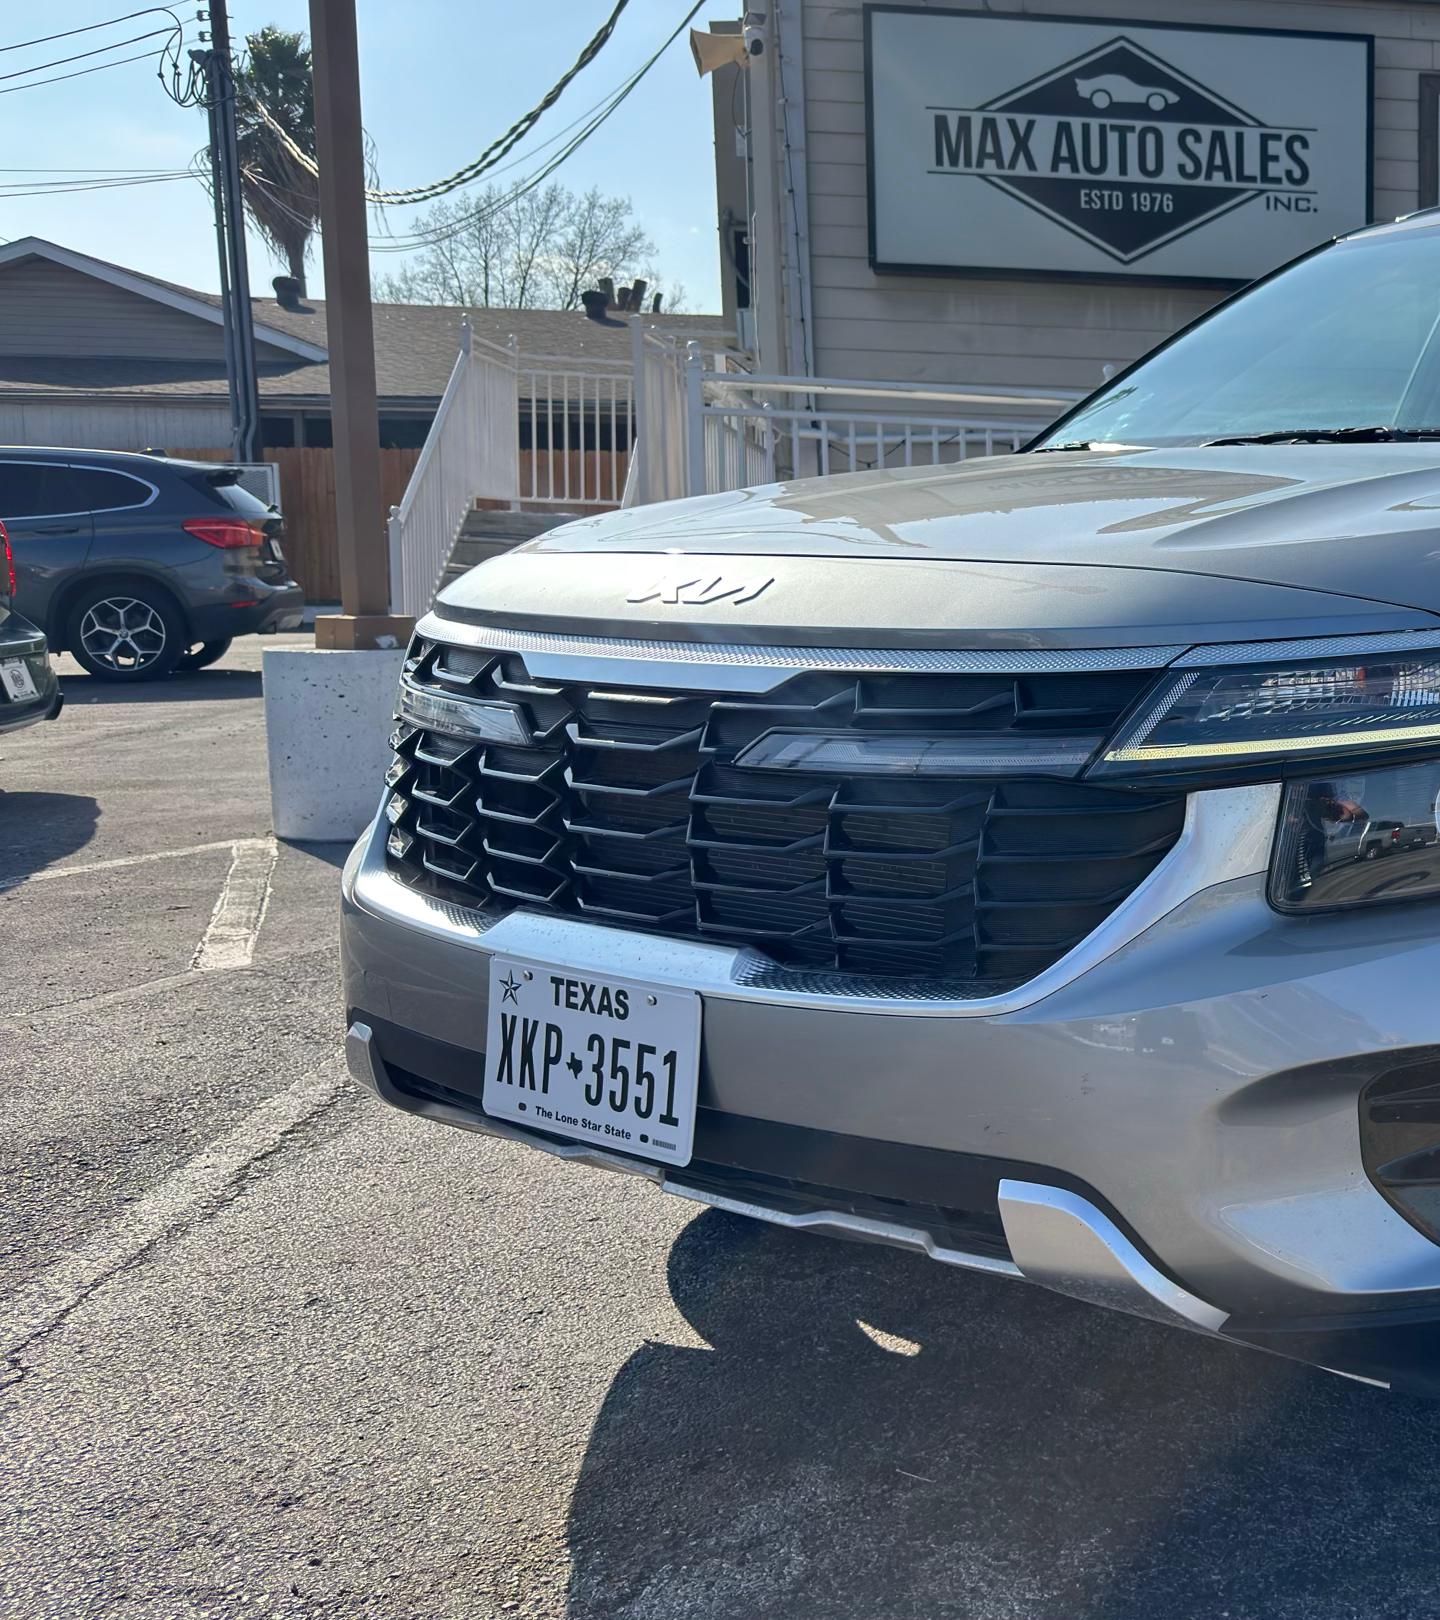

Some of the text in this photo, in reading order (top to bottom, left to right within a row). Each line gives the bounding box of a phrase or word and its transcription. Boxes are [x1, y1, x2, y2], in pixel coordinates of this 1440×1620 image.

[934, 114, 1311, 187] MAX AUTO SALES
[1080, 189, 1174, 214] ESTD 1976
[1265, 195, 1319, 214] INC.
[550, 976, 630, 1021] TEXAS
[535, 1105, 632, 1141] The Lone Star State
